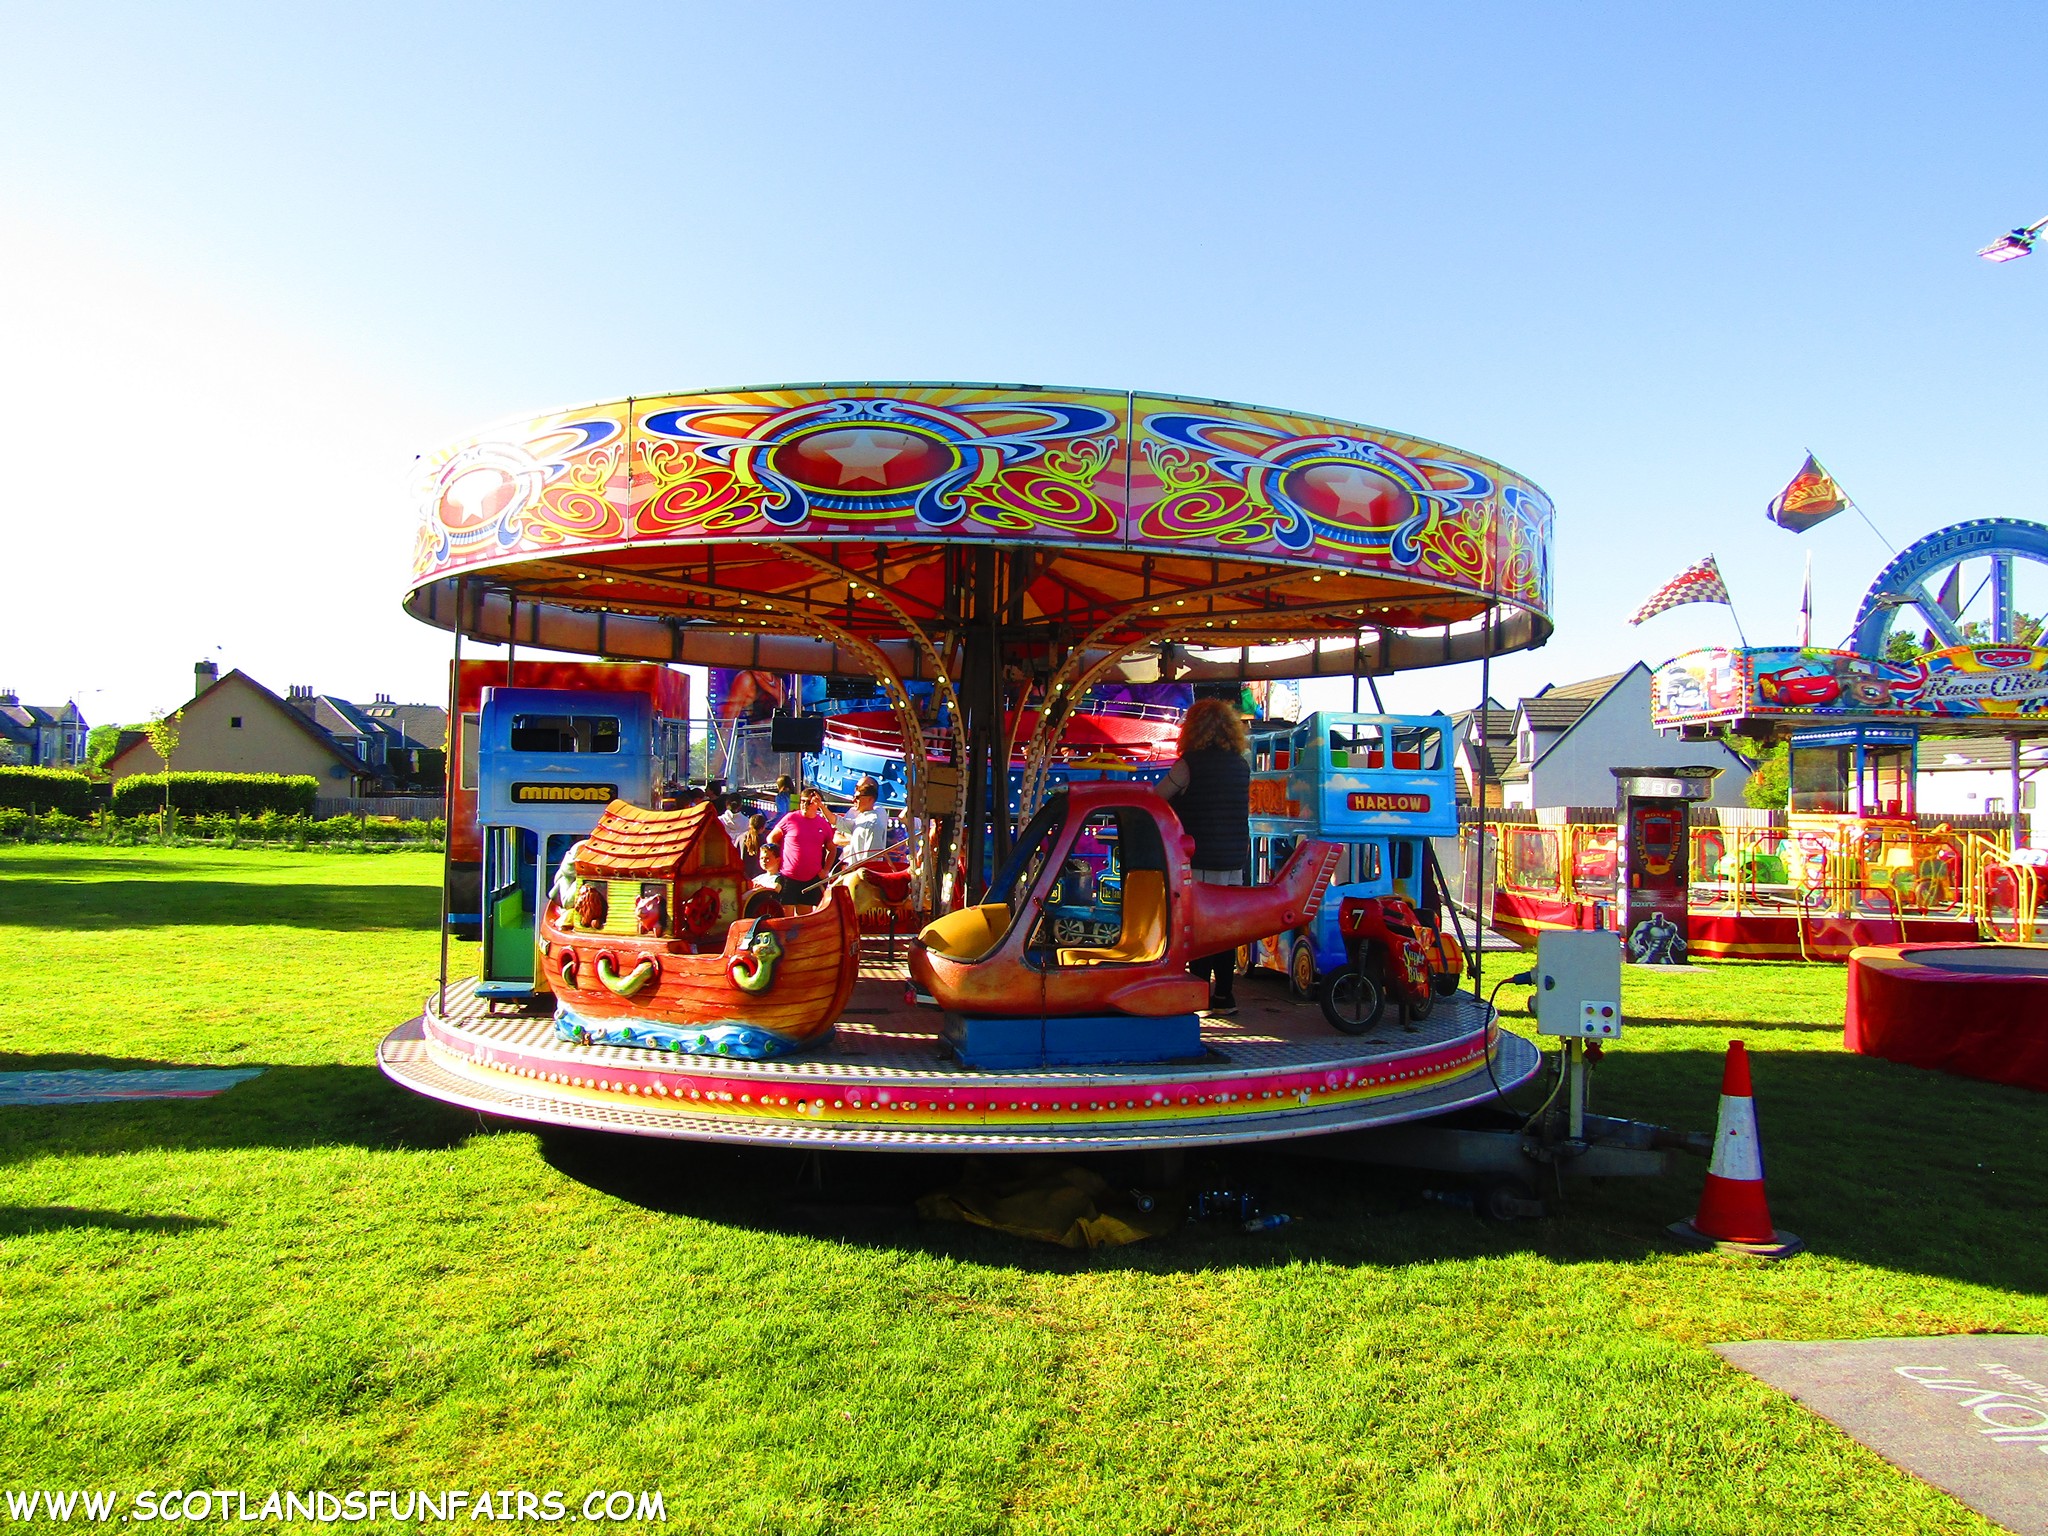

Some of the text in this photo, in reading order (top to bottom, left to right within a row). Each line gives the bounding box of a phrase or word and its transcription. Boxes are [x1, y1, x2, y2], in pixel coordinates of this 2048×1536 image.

[1892, 529, 1994, 586] MICHELIN
[1980, 652, 2025, 664] Cars
[1927, 676, 1988, 698] Race
[1354, 795, 1421, 811] HARLOW
[1352, 909, 1365, 930] 7
